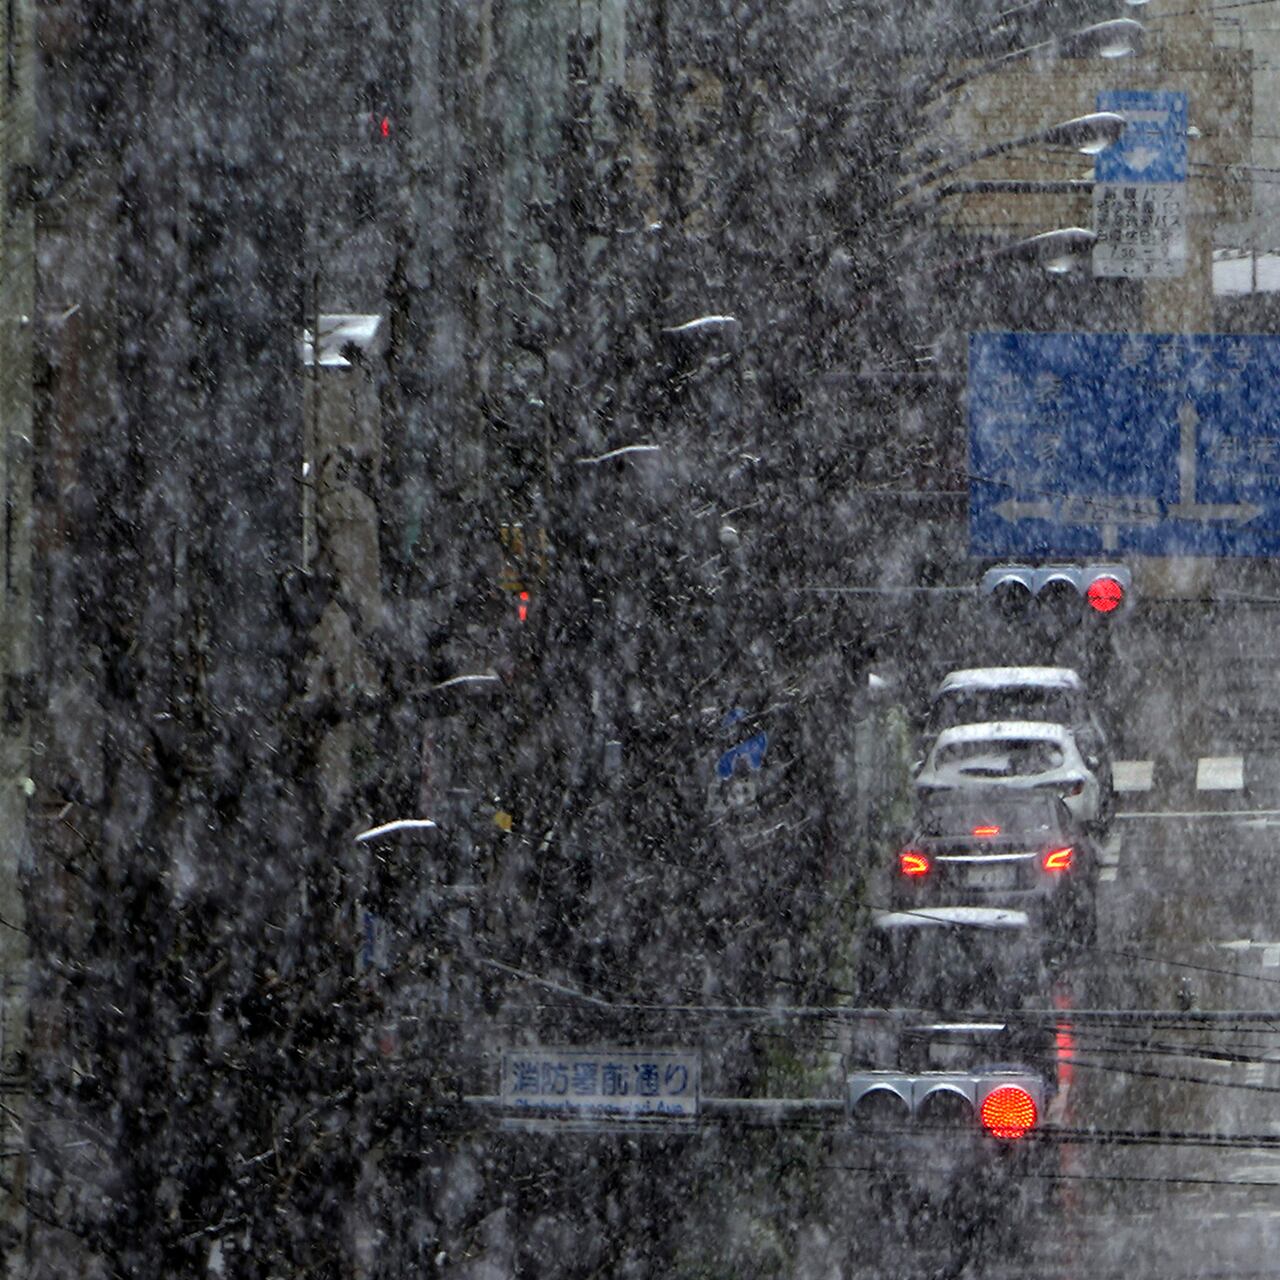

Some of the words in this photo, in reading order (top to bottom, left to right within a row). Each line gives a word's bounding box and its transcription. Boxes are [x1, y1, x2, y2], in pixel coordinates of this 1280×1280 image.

[512, 1061, 689, 1096] 消防署前通り
